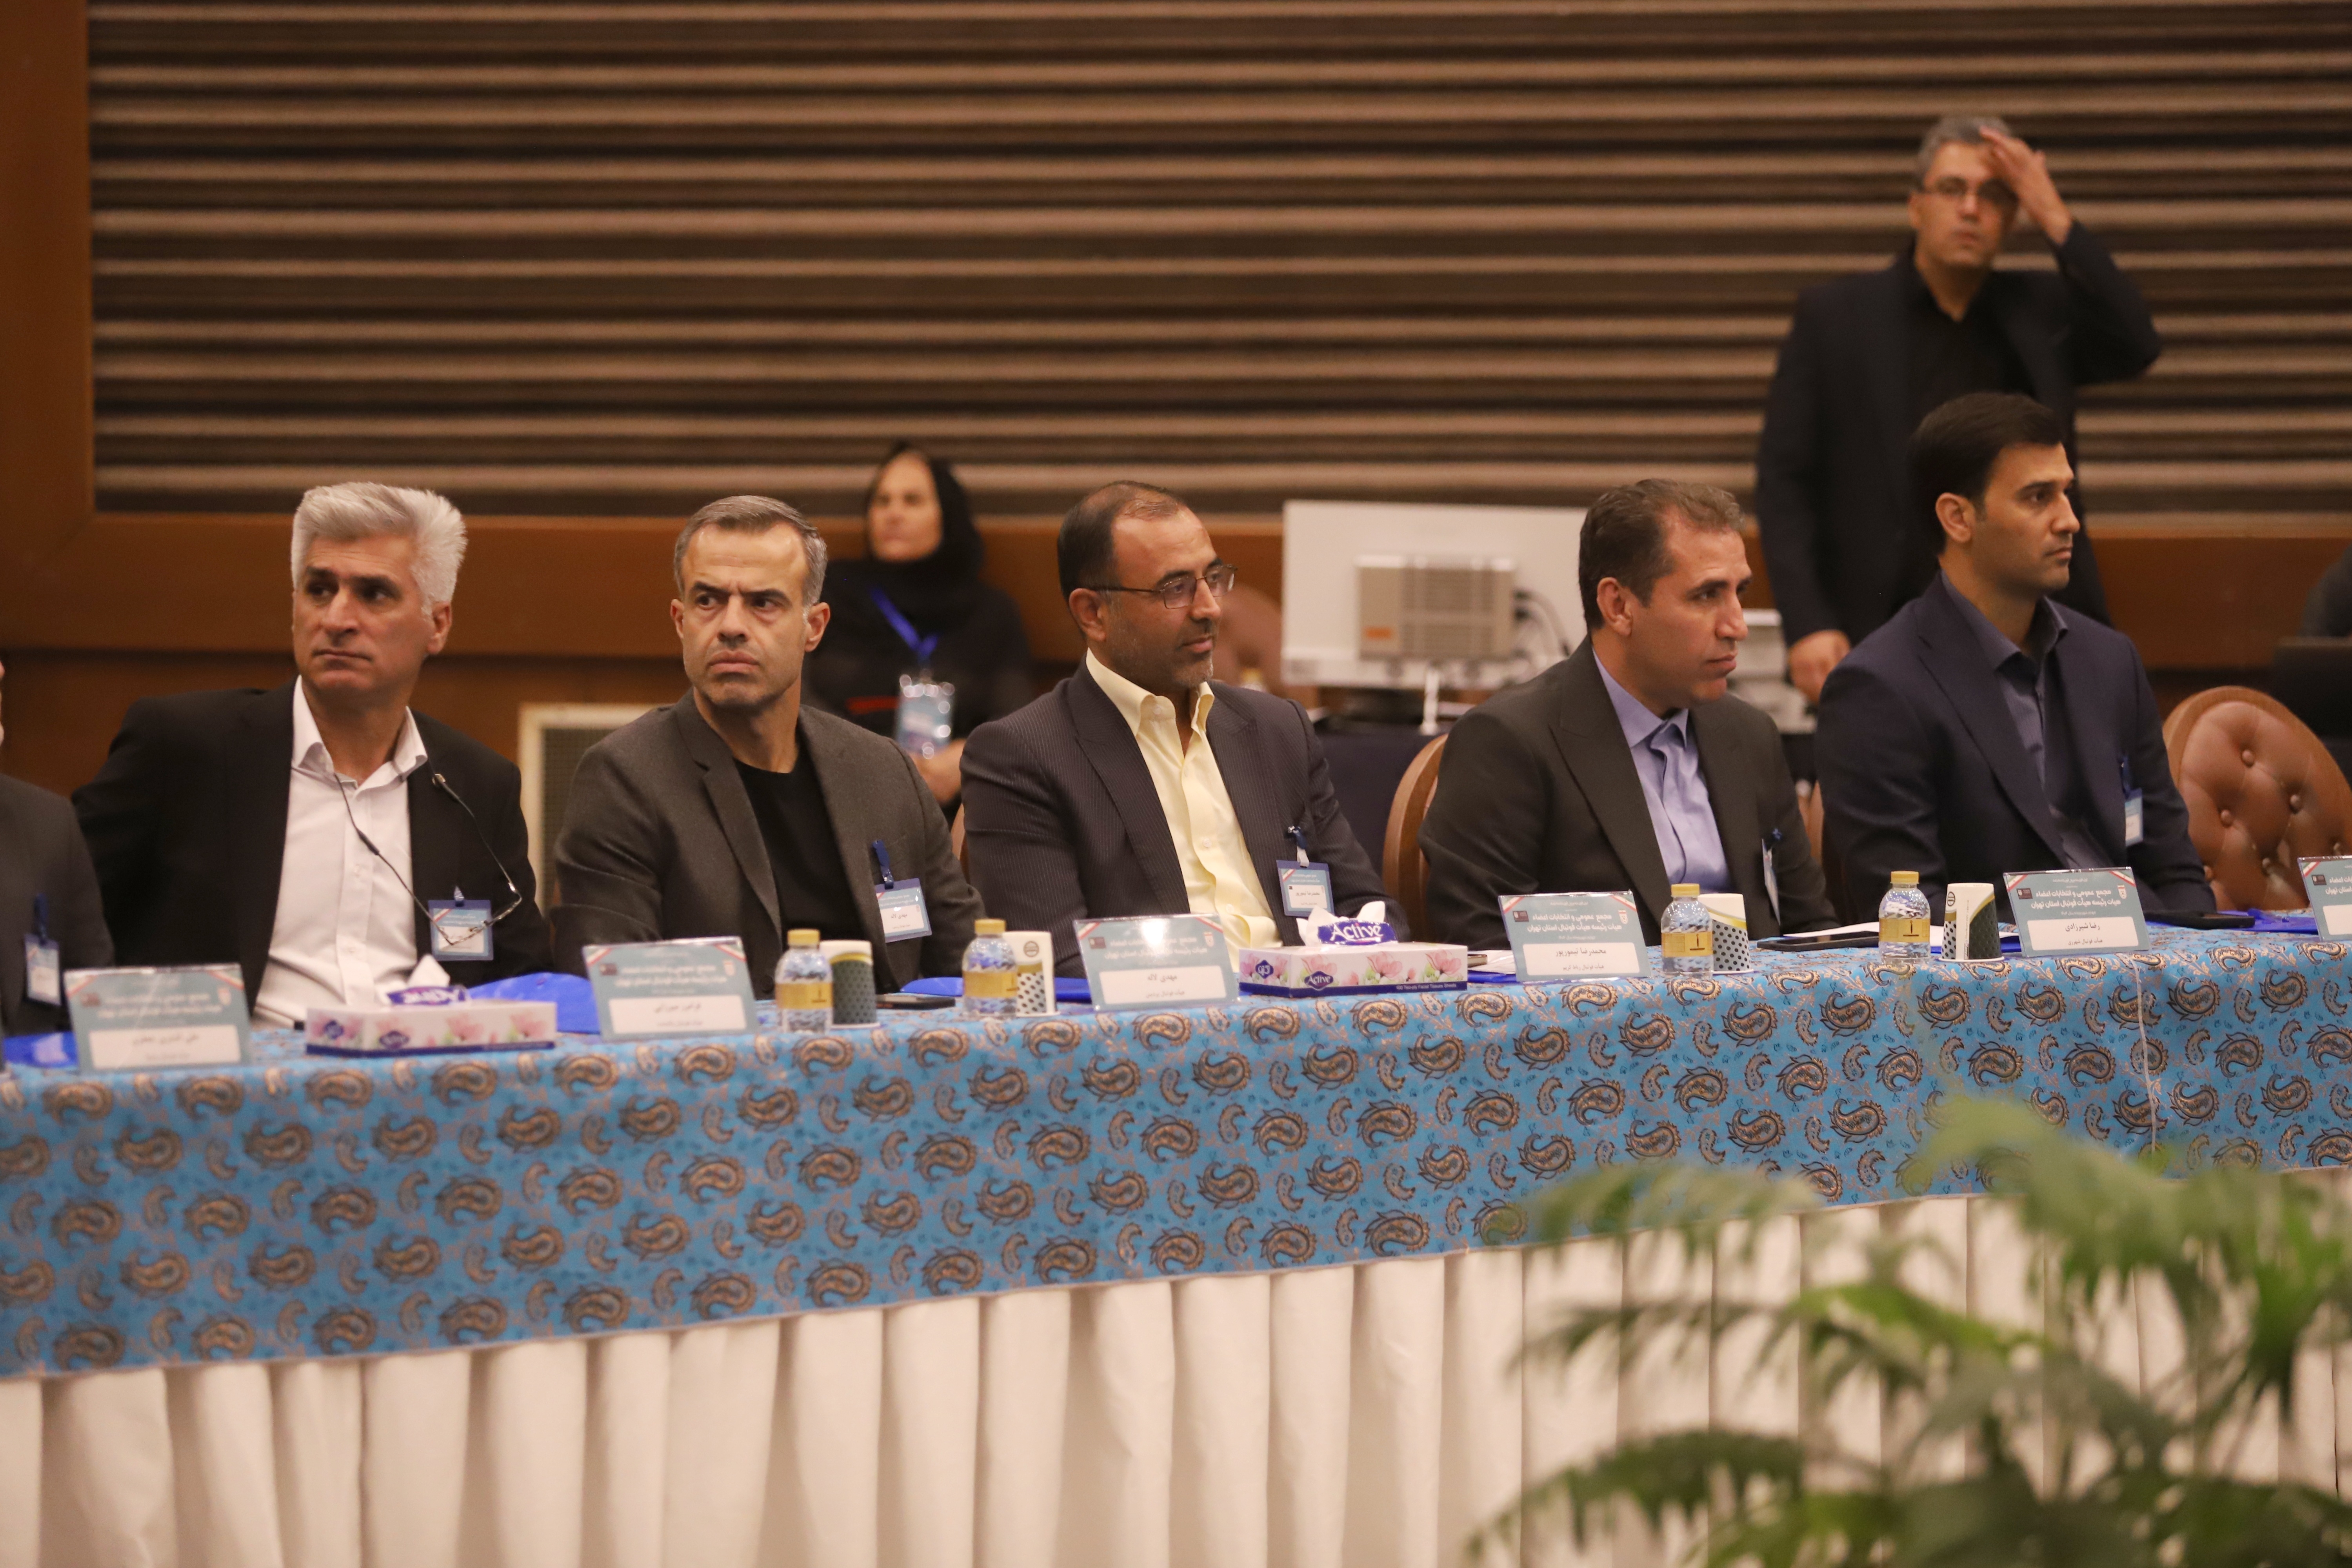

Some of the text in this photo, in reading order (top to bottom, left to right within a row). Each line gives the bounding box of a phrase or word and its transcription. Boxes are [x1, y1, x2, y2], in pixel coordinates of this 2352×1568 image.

[2052, 889, 2072, 898] انتخابات
[2096, 890, 2111, 898] مجمع
[2325, 887, 2338, 895] تهران
[2031, 901, 2044, 910] تهران
[2045, 900, 2059, 908] استان
[2060, 899, 2076, 908] فوتبال
[2092, 898, 2107, 907] رئیسه
[1596, 914, 1612, 922] مجمع
[1558, 923, 1575, 932] فوتبال
[2065, 922, 2100, 932] رضا شیرزادی
[1330, 923, 1384, 941] Active
[1580, 947, 1607, 956] محمدرضا
[1160, 974, 1177, 983] مهدی
[1306, 976, 1330, 985] Active
